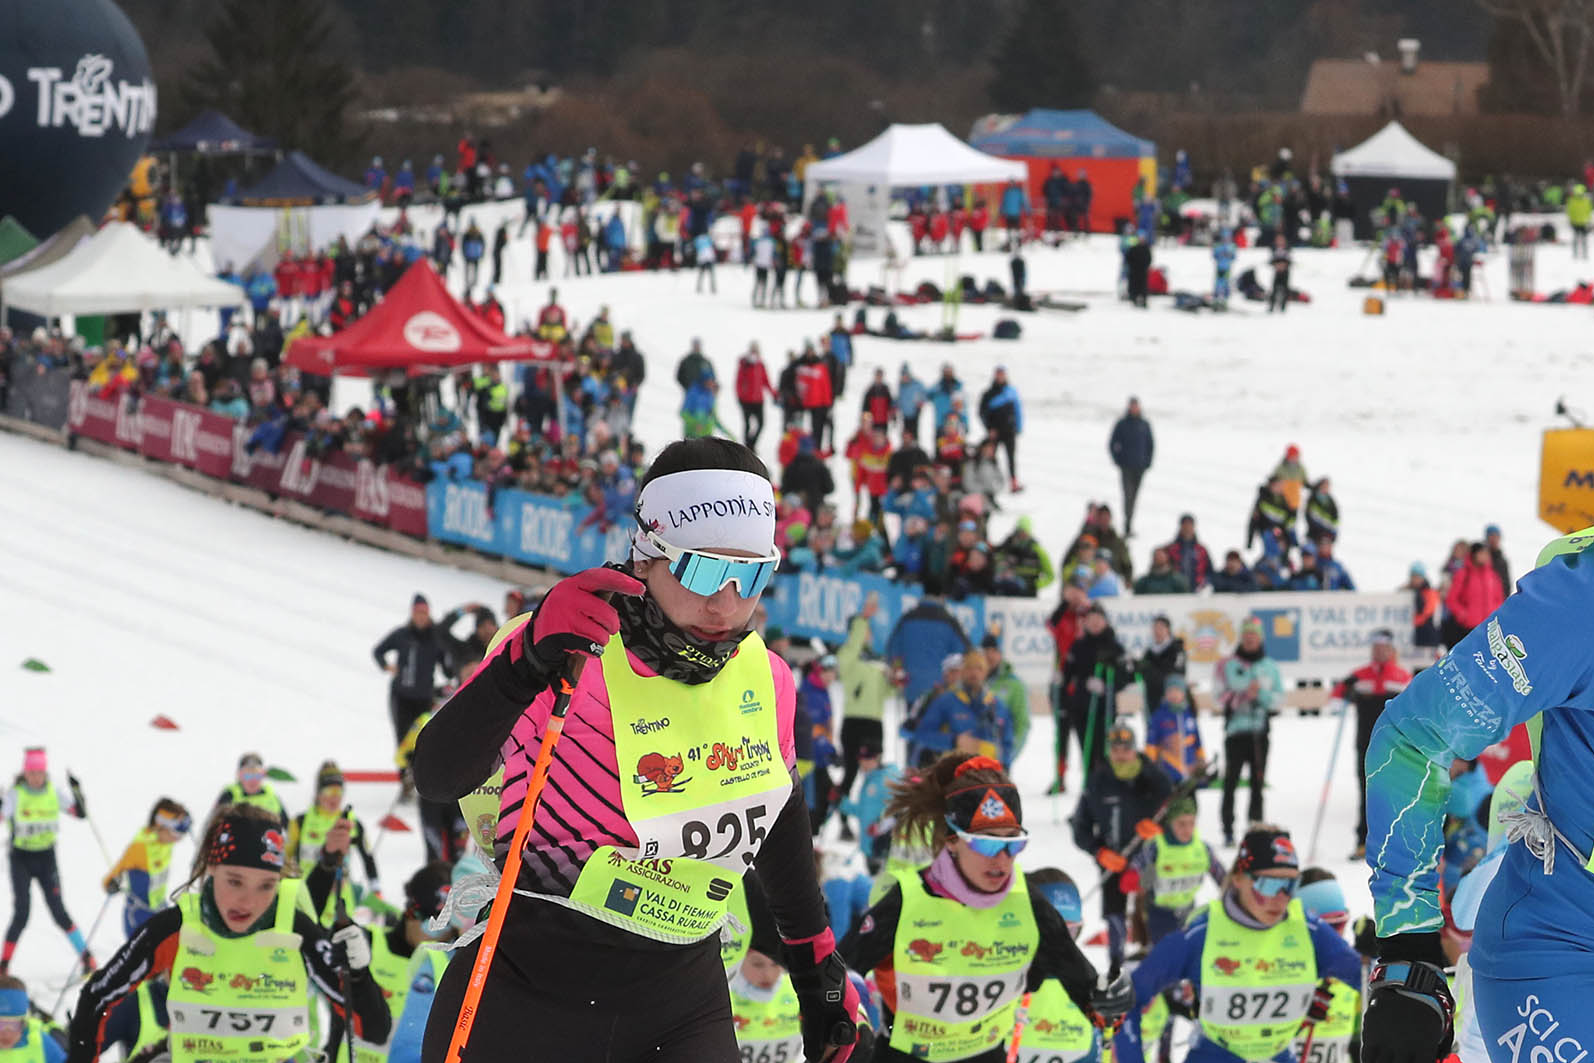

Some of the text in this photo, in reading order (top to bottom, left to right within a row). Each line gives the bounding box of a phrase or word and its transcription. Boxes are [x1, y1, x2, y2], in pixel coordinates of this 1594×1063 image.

[668, 495, 762, 528] LAPPONIA
[1444, 659, 1502, 727] FREZZA
[630, 717, 670, 735] TRENTINO
[681, 804, 767, 866] 825
[626, 863, 691, 894] ASSICURAZIONI
[640, 904, 710, 930] CASSA RURALE
[645, 889, 719, 920] VAL DI FIEMME
[928, 980, 1006, 1017] 789
[1228, 991, 1289, 1020] 872
[200, 1009, 276, 1034] 757
[919, 1021, 946, 1036] ITAS
[1517, 994, 1560, 1041] SCI
